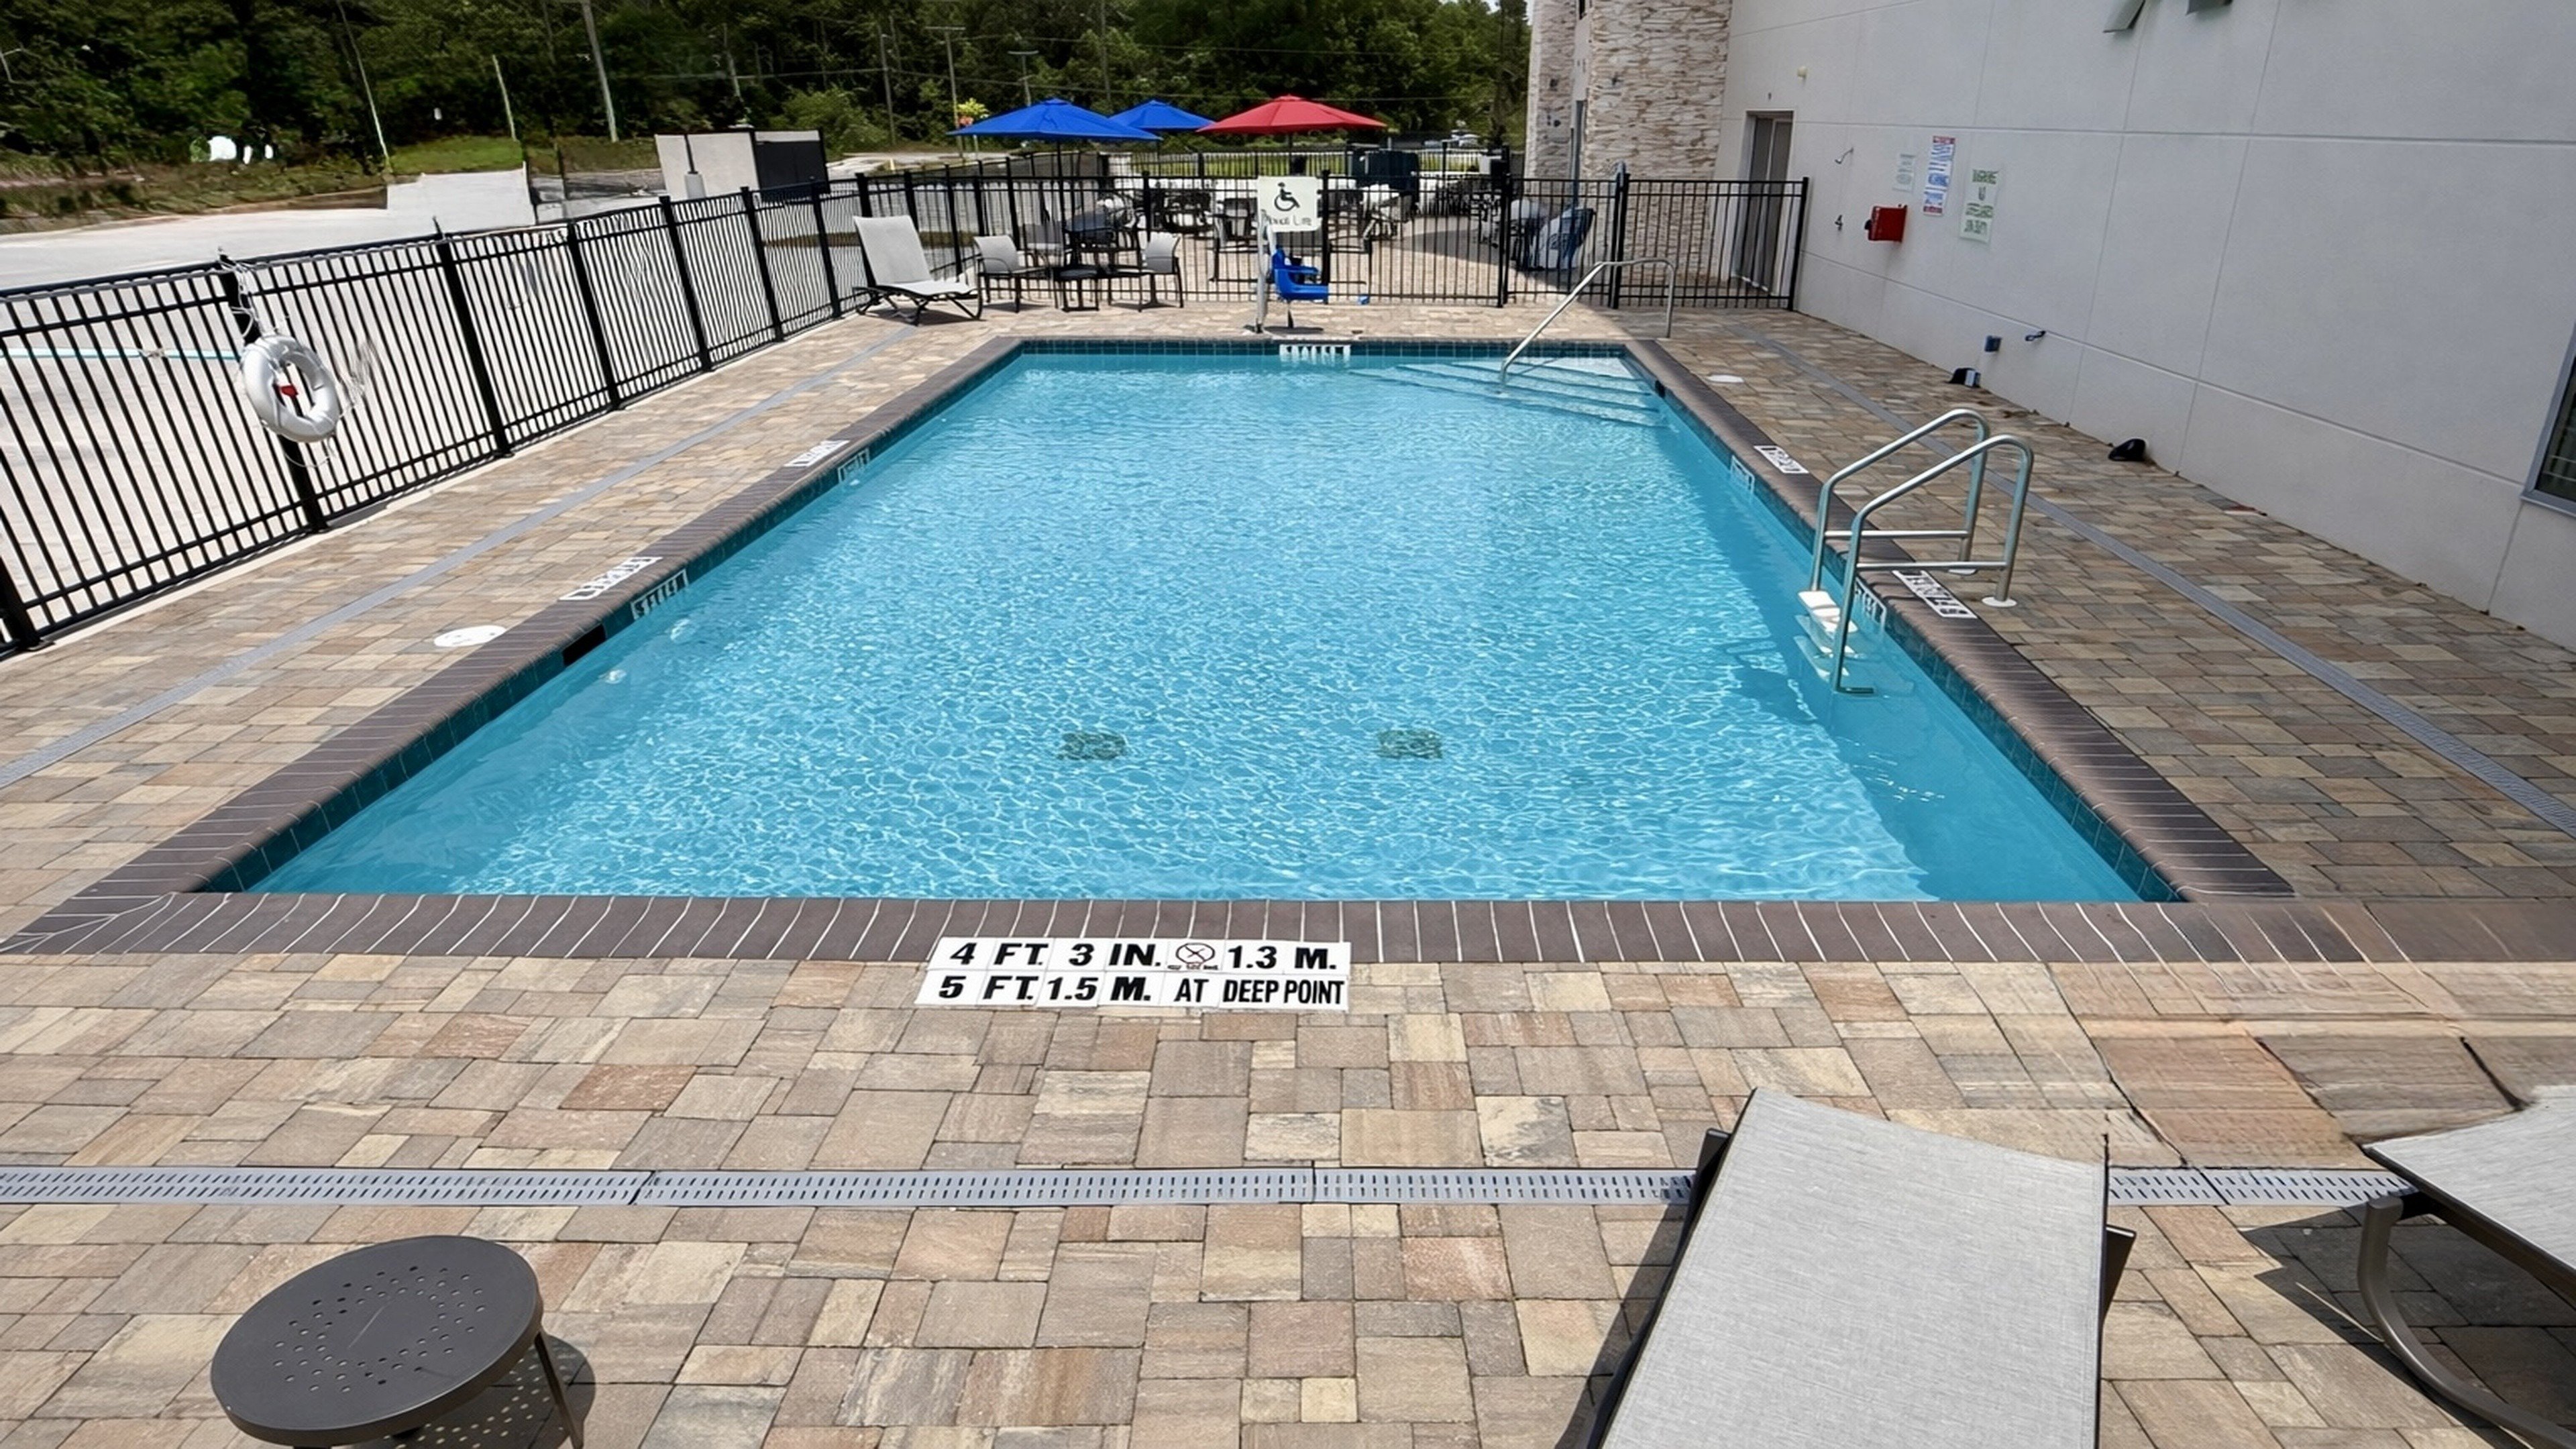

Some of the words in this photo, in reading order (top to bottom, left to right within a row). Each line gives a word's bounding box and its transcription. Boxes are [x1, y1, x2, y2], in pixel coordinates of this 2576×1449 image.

[950, 943, 977, 965] 4
[994, 943, 1049, 965] FT.
[1069, 943, 1095, 967] 3
[1108, 943, 1161, 967] IN.
[1228, 945, 1277, 969] 1.3
[1294, 947, 1337, 969] M.
[939, 975, 967, 999] 5
[983, 975, 1039, 1000] FT.
[1047, 976, 1099, 1000] 1.5
[1110, 977, 1151, 1002] M.
[1174, 978, 1210, 1003] AT
[1222, 979, 1279, 1003] DEEP
[1283, 979, 1345, 1004] POINT
